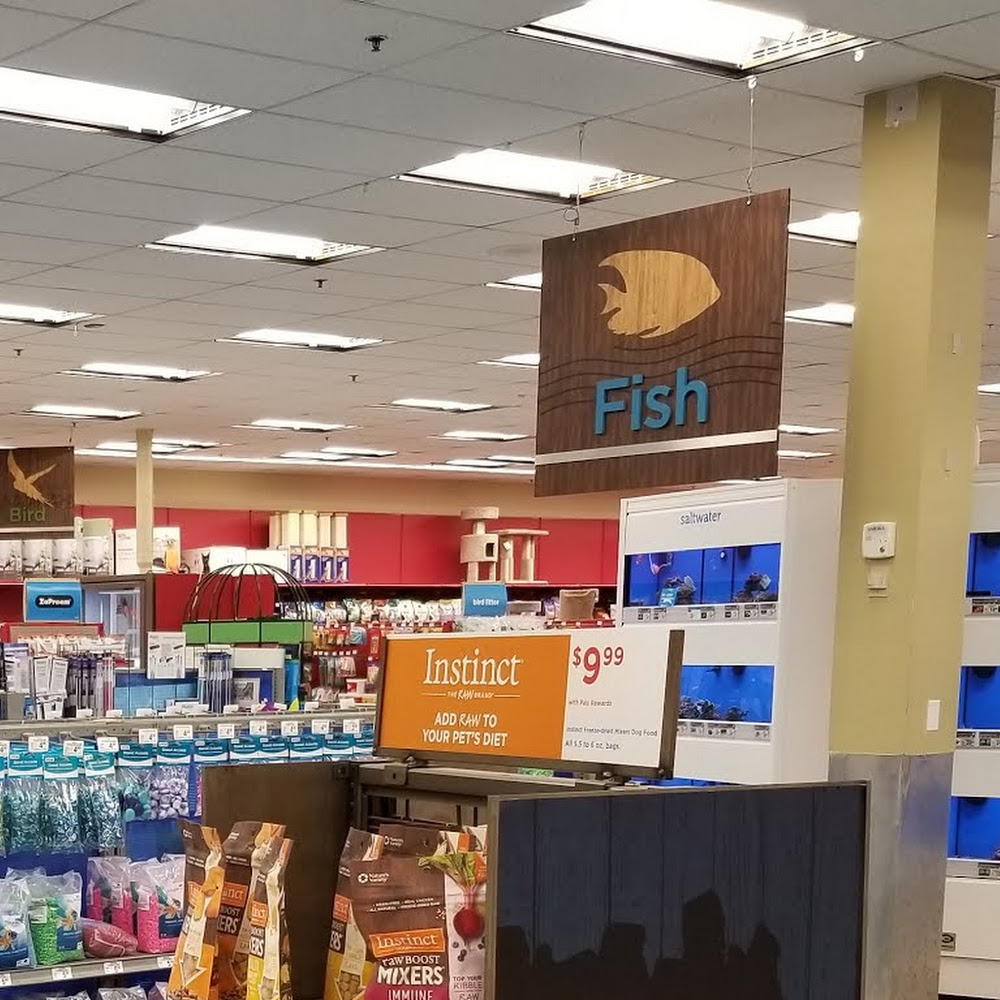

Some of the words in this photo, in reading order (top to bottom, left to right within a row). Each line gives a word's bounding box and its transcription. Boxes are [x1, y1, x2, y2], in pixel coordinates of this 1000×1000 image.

[595, 367, 708, 435] Fish
[10, 506, 46, 521] Bird
[680, 511, 721, 525] saltwater
[423, 648, 521, 686] Instinct
[457, 689, 474, 700] RAW
[434, 712, 457, 726] ADD
[458, 713, 482, 727] RAW
[483, 714, 498, 728] TO
[422, 729, 449, 744] YOUR
[452, 730, 481, 745] PET'S
[482, 732, 507, 747] DIET
[631, 729, 642, 737] Dog
[643, 729, 658, 737] Food
[376, 934, 440, 949] Instinct
[377, 965, 444, 985] MIXERS
[453, 981, 482, 990] KIBBLE
[459, 992, 479, 1000] RAW
